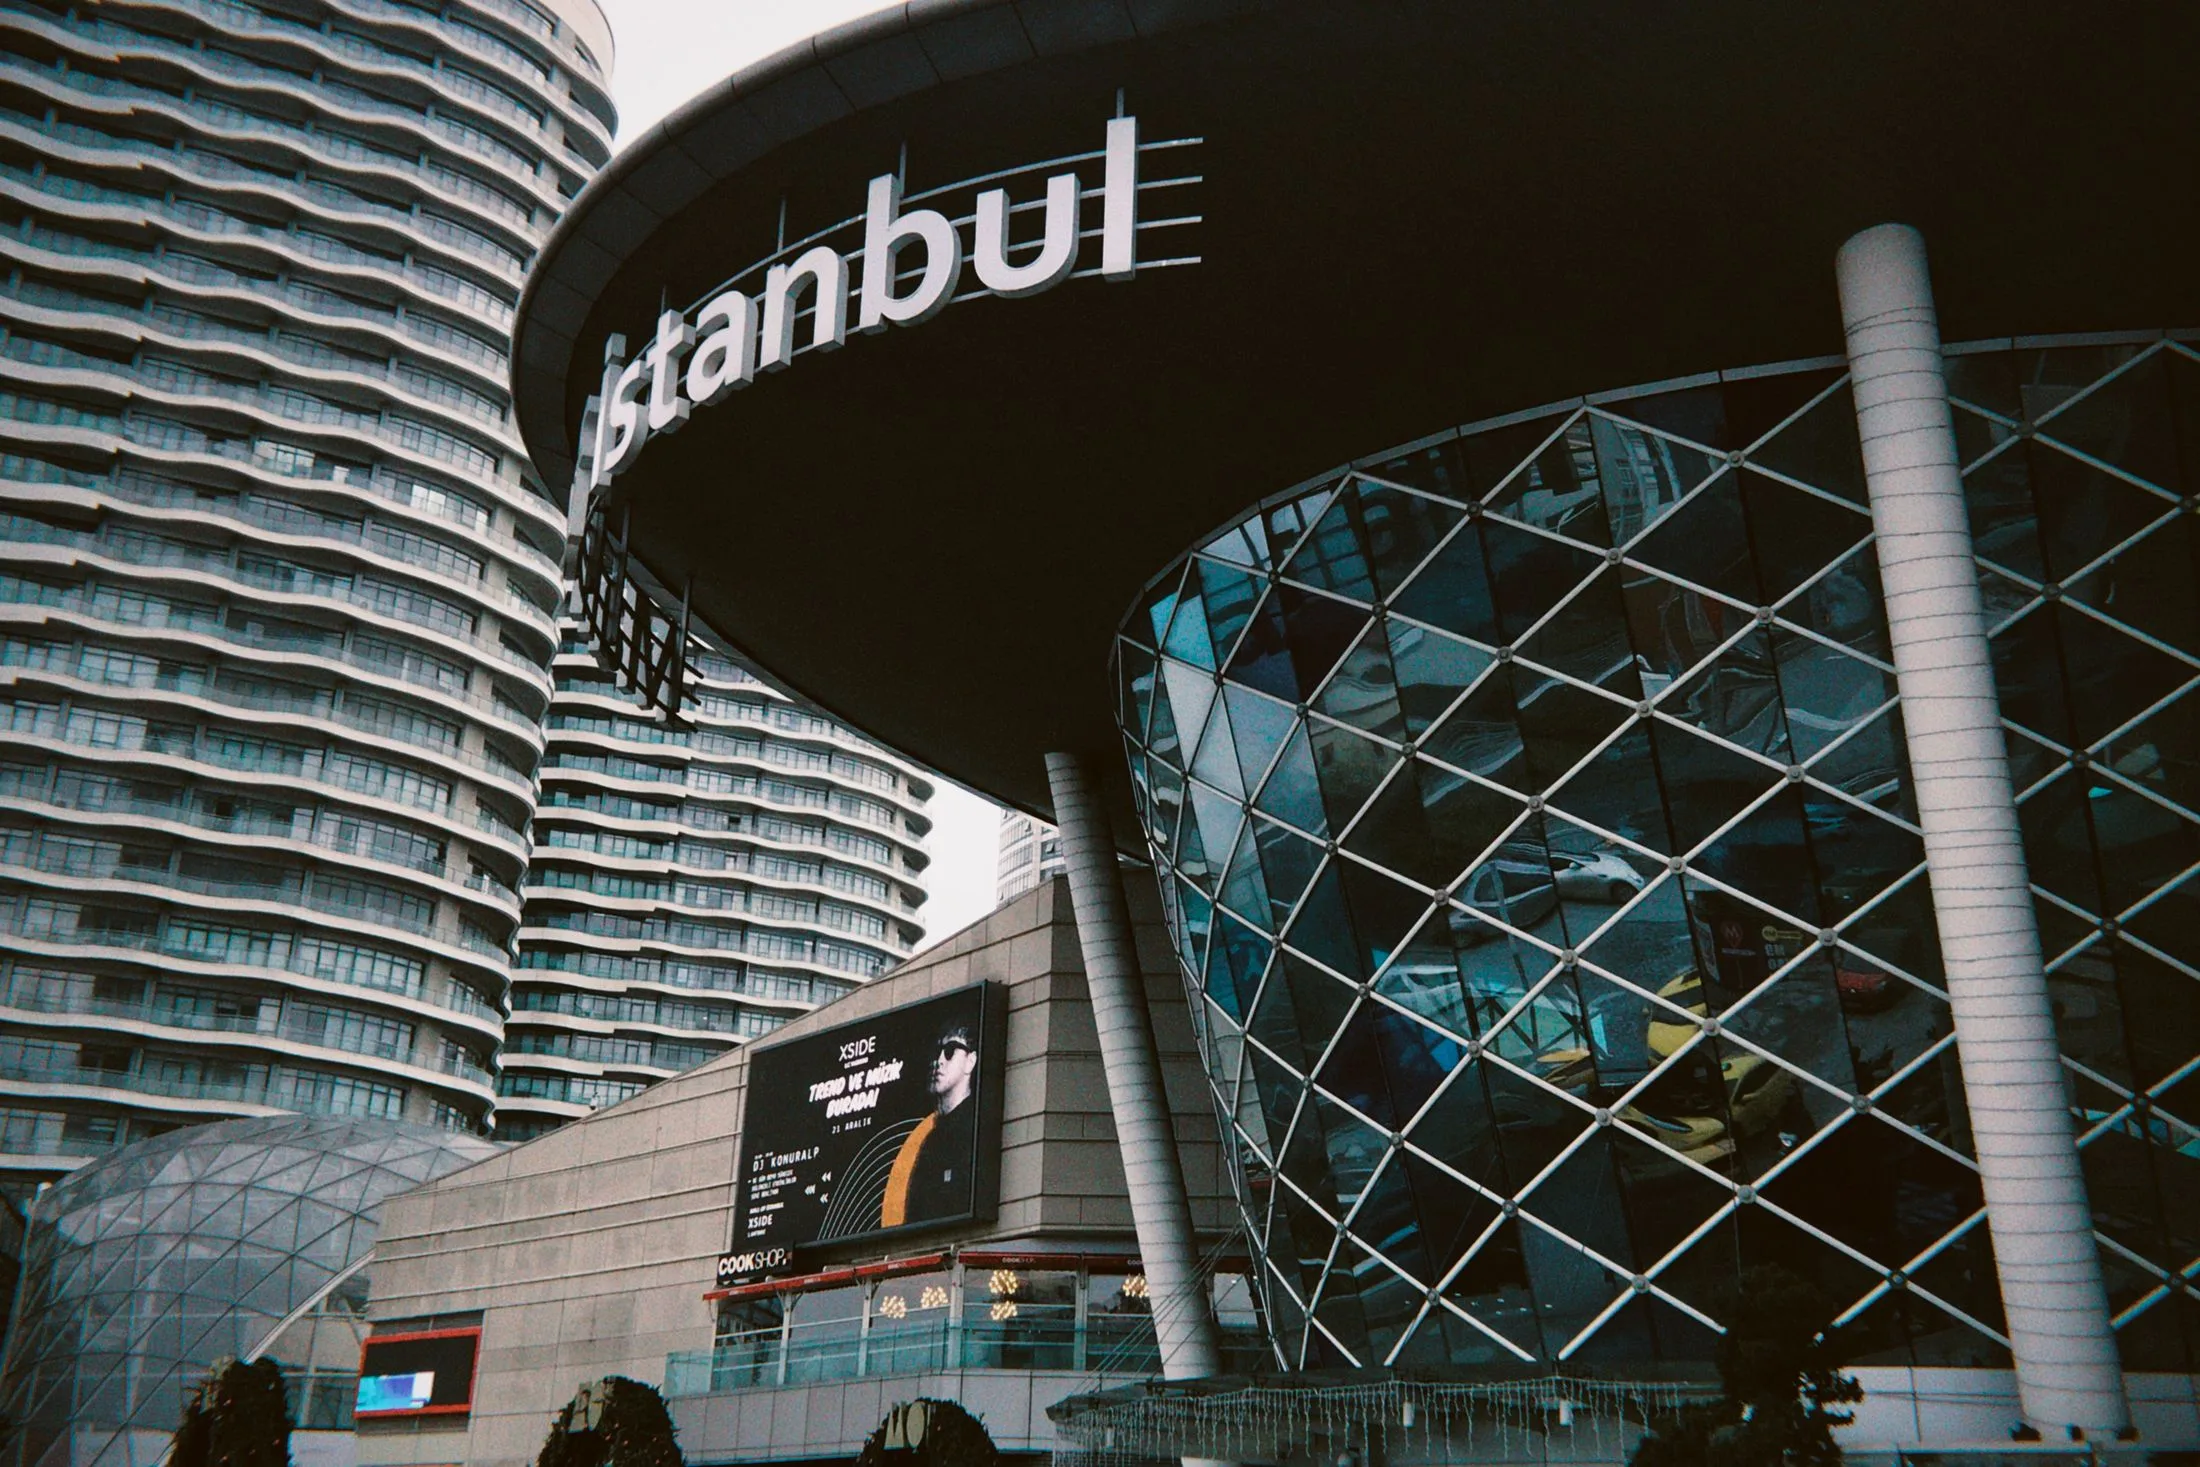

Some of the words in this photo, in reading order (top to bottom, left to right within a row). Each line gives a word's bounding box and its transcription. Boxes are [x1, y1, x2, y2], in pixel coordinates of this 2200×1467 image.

[839, 1036, 876, 1062] XSIDE
[809, 1077, 846, 1103] TREND
[848, 1071, 865, 1092] VE
[753, 1159, 764, 1172] DJ
[771, 1146, 820, 1168] KONURALP
[747, 1214, 774, 1229] XSIDE
